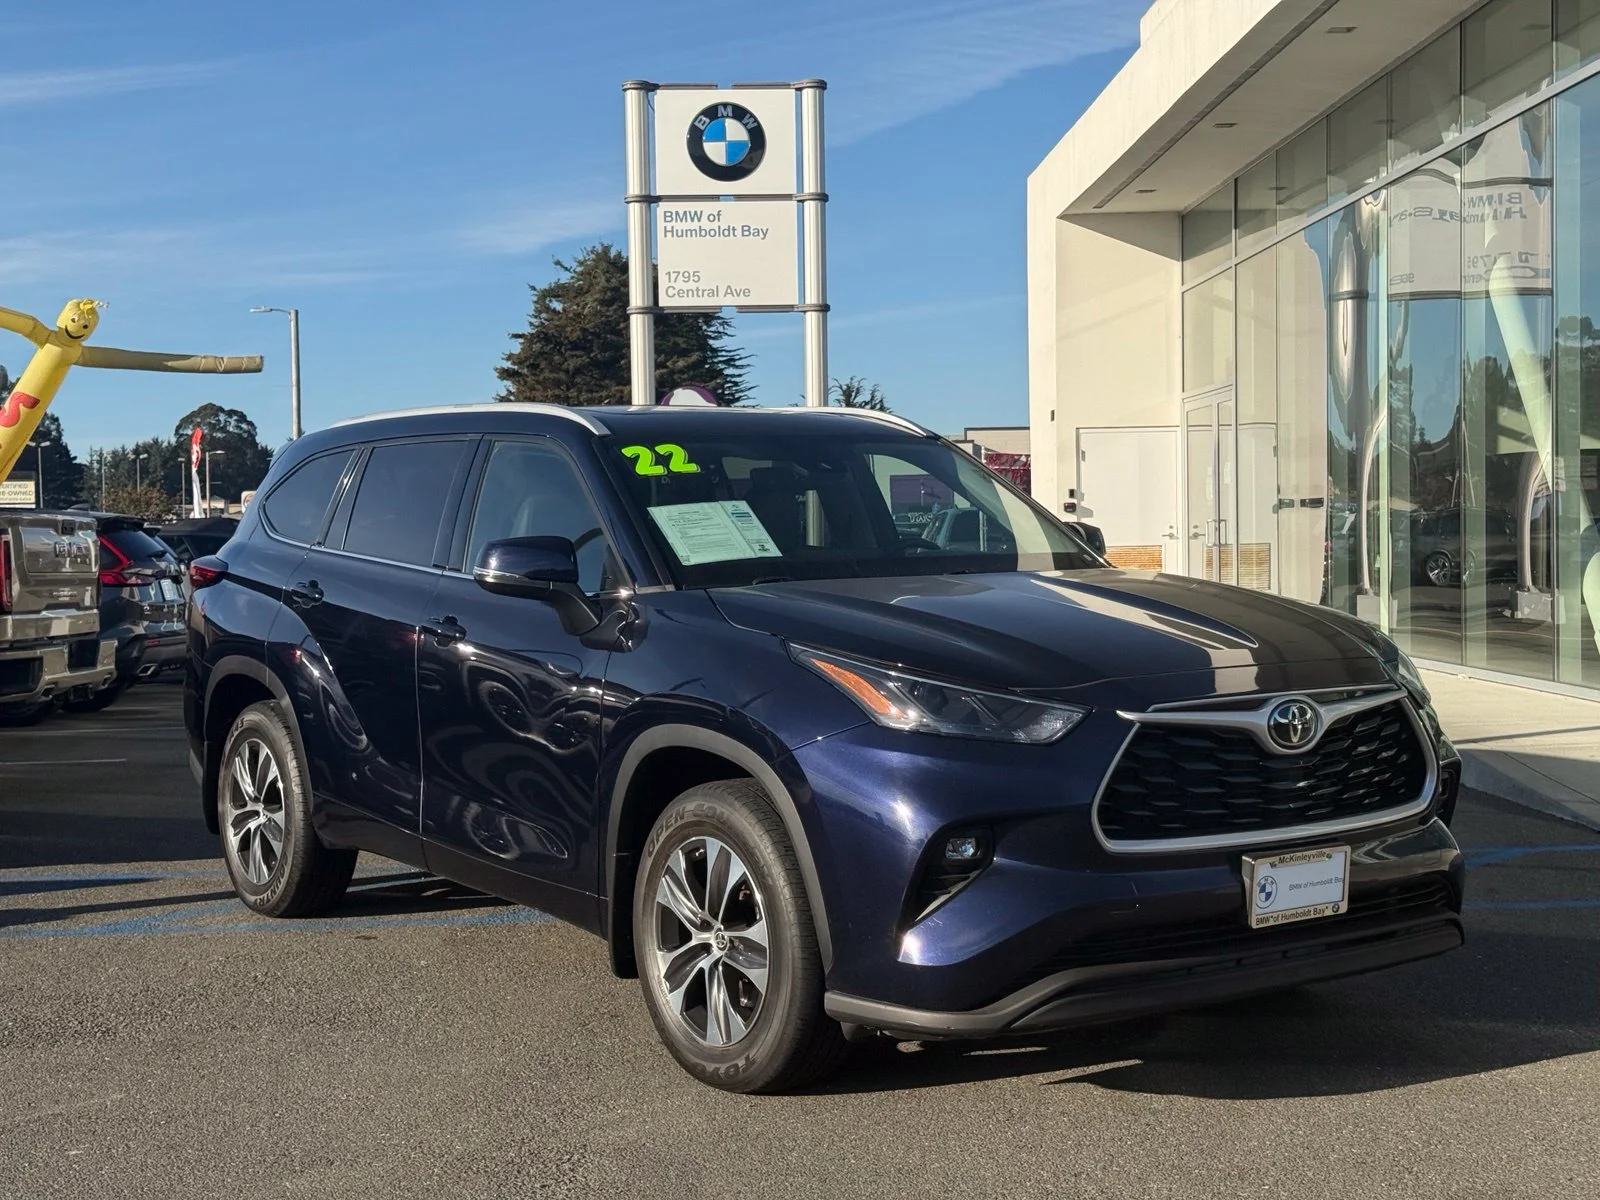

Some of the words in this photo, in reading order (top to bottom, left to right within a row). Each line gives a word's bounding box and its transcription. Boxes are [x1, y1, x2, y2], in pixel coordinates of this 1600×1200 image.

[694, 104, 757, 131] BMW
[663, 210, 703, 223] BMW
[707, 210, 722, 223] of
[663, 225, 737, 238] Humboldt
[741, 225, 769, 240] Bay
[665, 271, 701, 283] 1795
[665, 285, 719, 298] Central
[723, 285, 751, 298] Ave
[621, 443, 700, 477] 22
[647, 806, 686, 858] OPEN
[1278, 851, 1327, 864] McKinleyville
[1281, 909, 1312, 921] Humboldt
